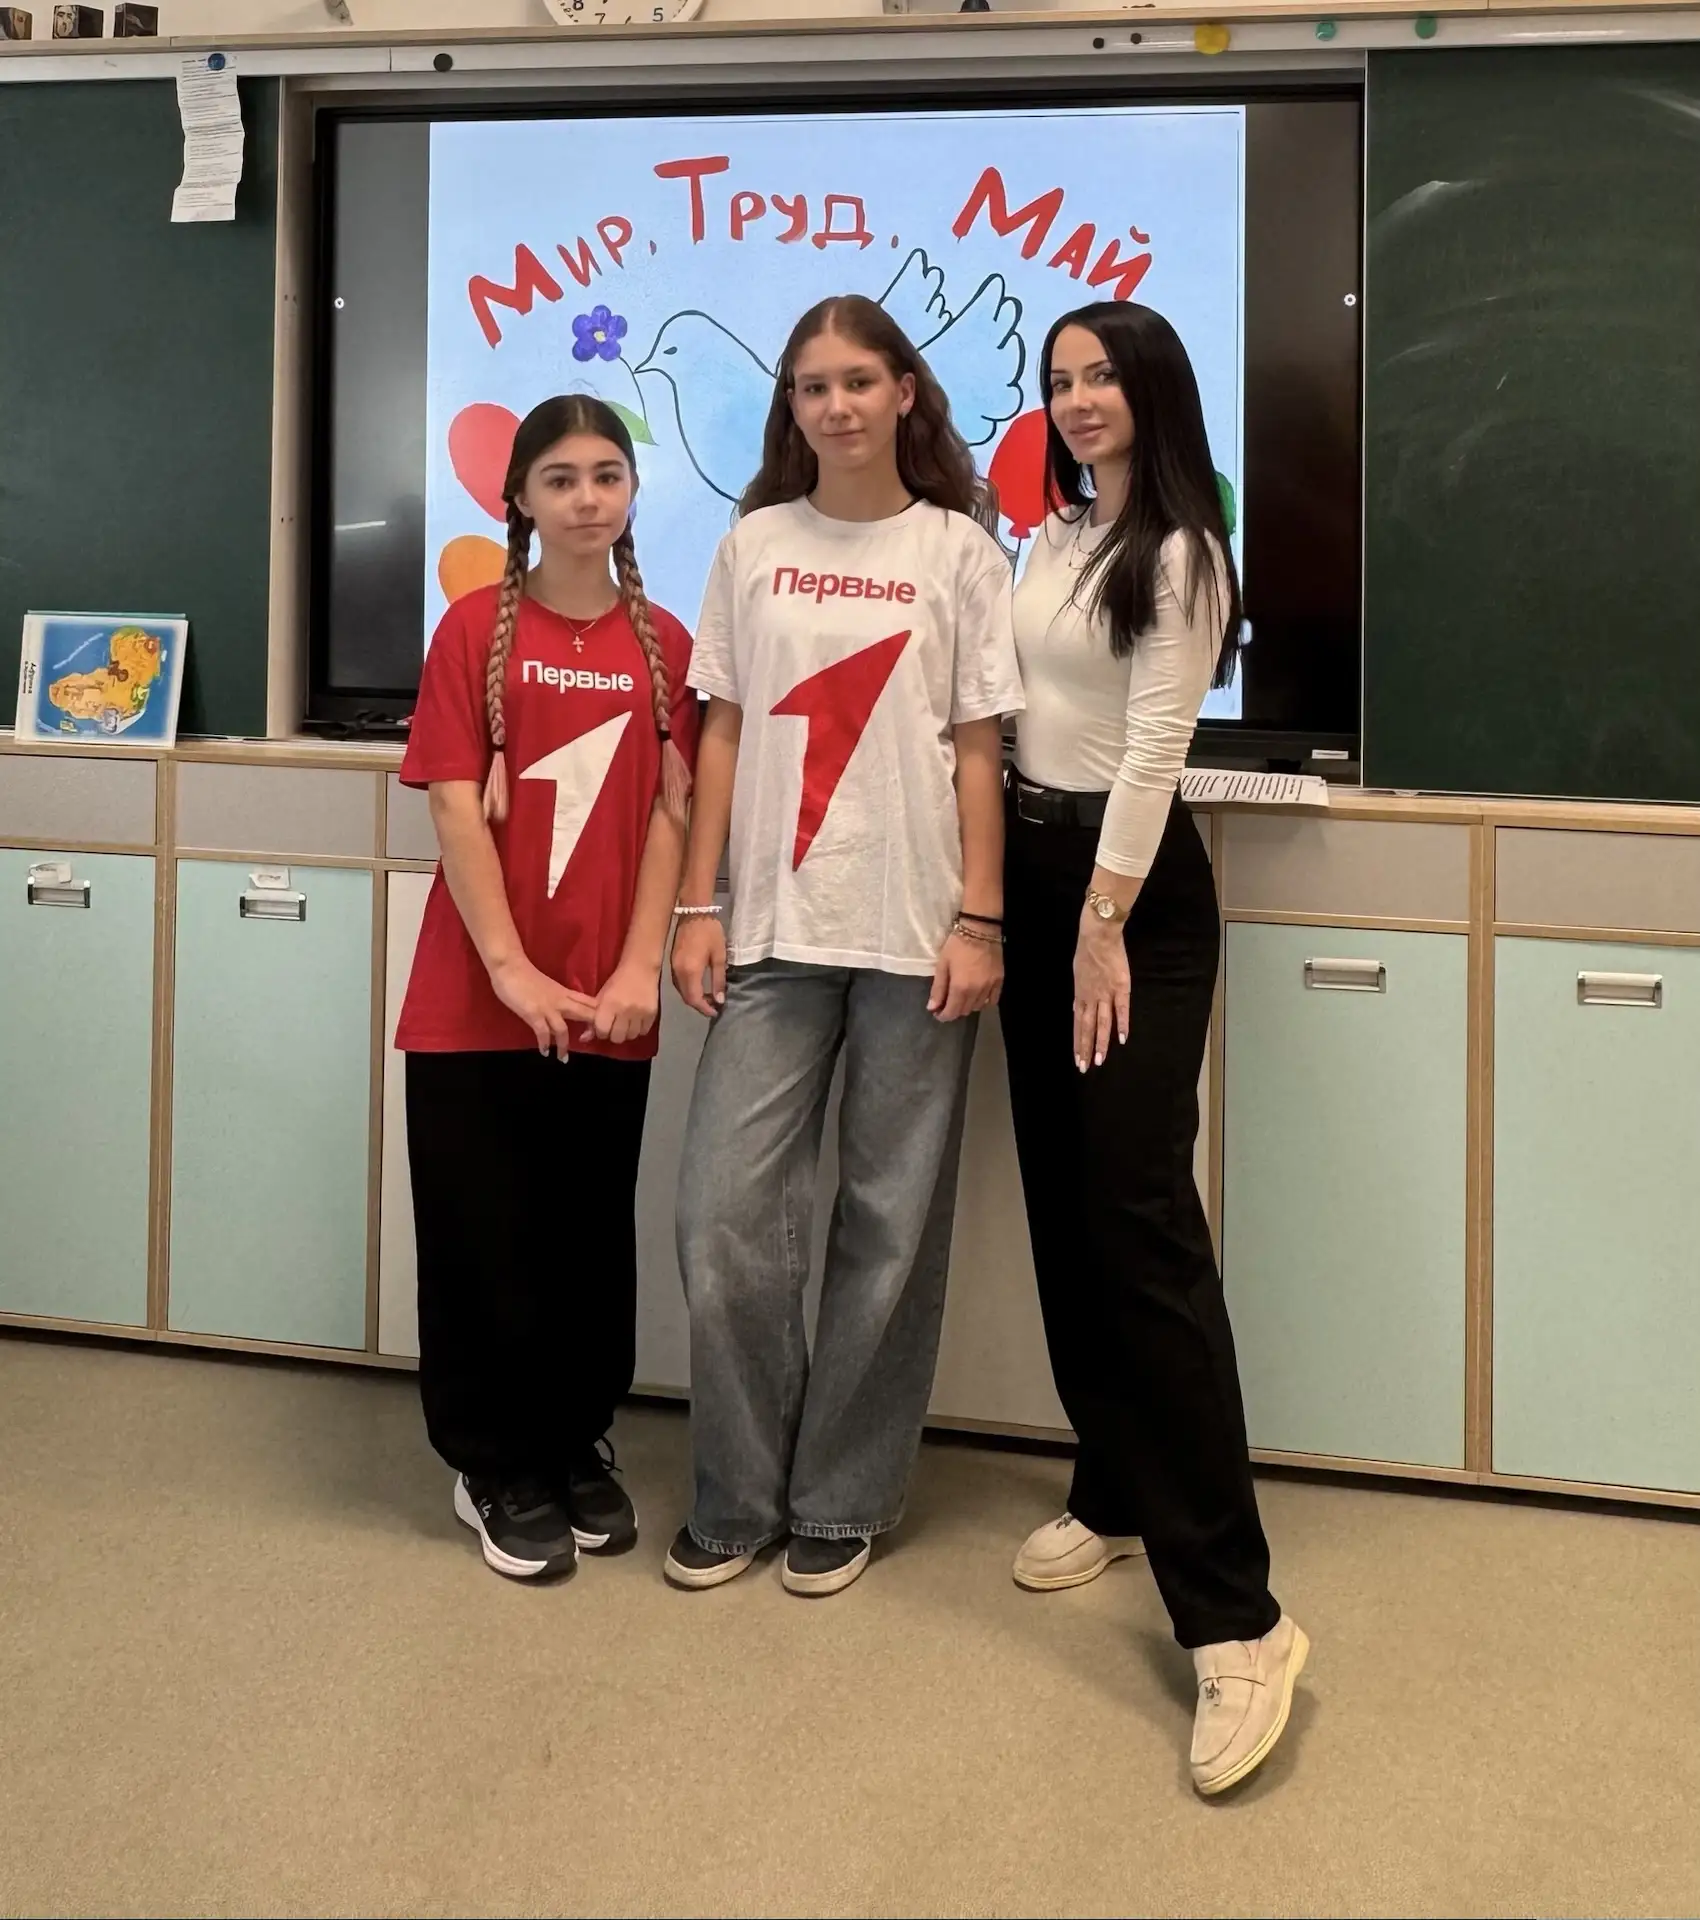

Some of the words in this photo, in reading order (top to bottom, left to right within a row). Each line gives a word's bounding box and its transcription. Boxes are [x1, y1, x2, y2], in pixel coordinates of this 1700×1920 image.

[652, 7, 664, 22] 5
[772, 567, 917, 604] Первые
[522, 660, 634, 694] Первые
